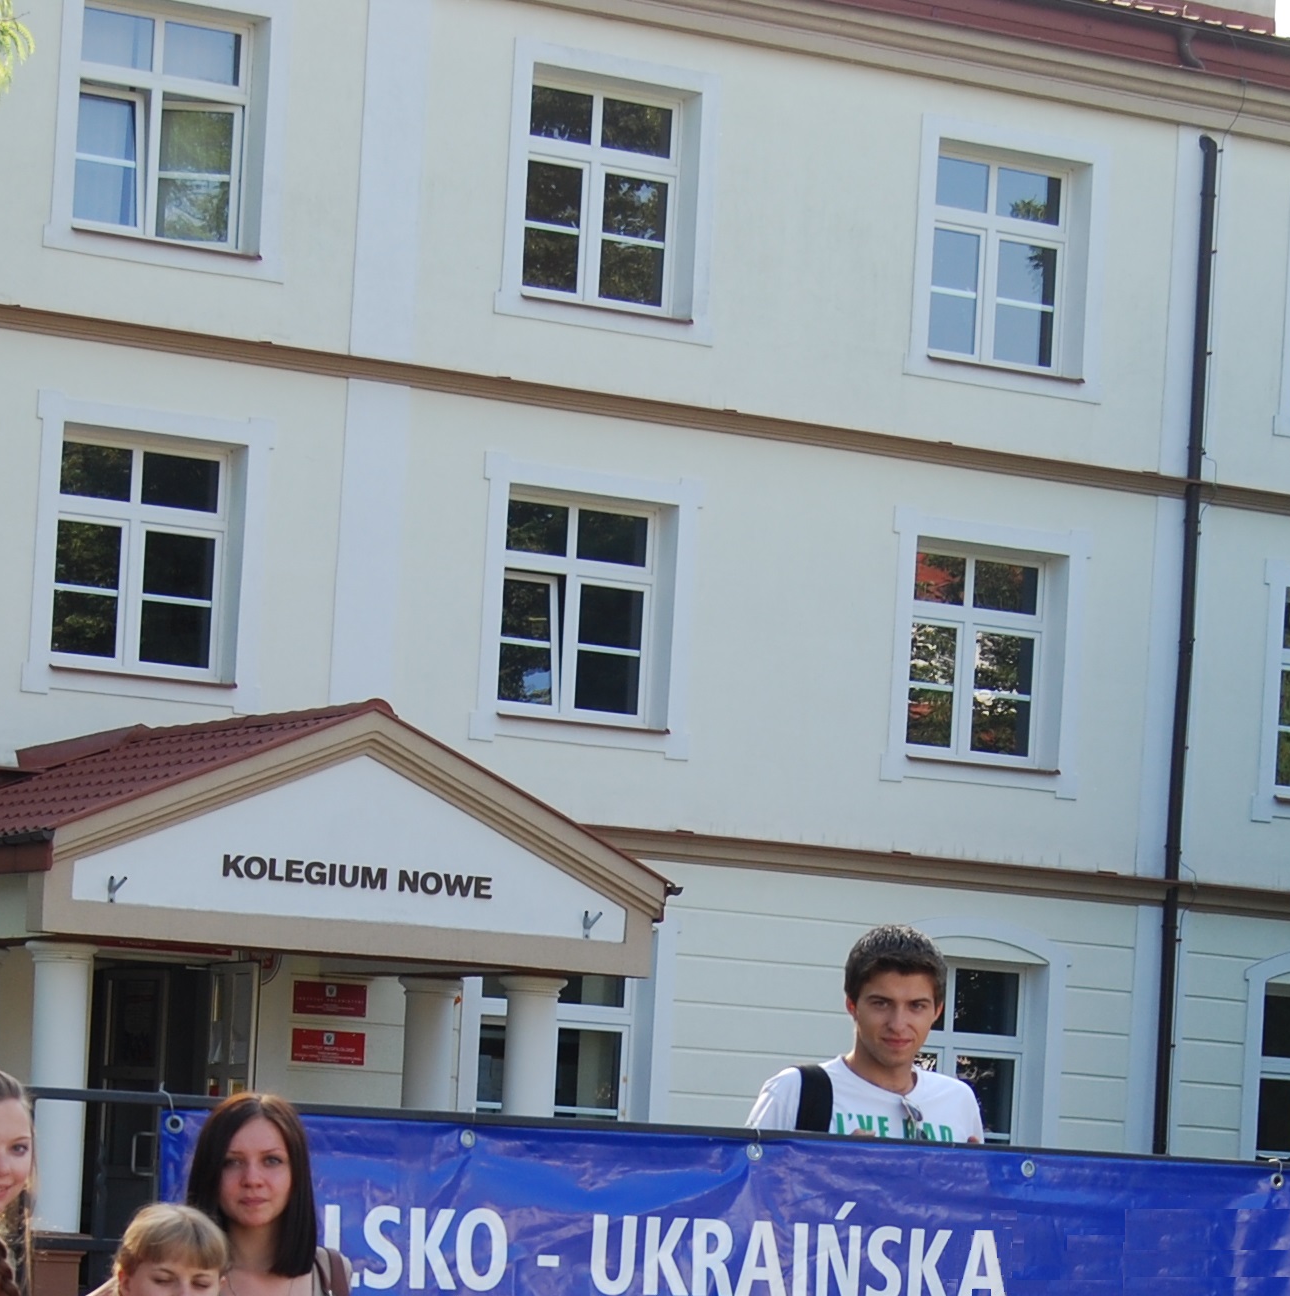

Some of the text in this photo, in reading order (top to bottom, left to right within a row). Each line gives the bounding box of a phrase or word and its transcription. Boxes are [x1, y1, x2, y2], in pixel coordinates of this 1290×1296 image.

[221, 853, 493, 900] KOLEGIUM NOWE
[323, 1203, 509, 1293] LSKO
